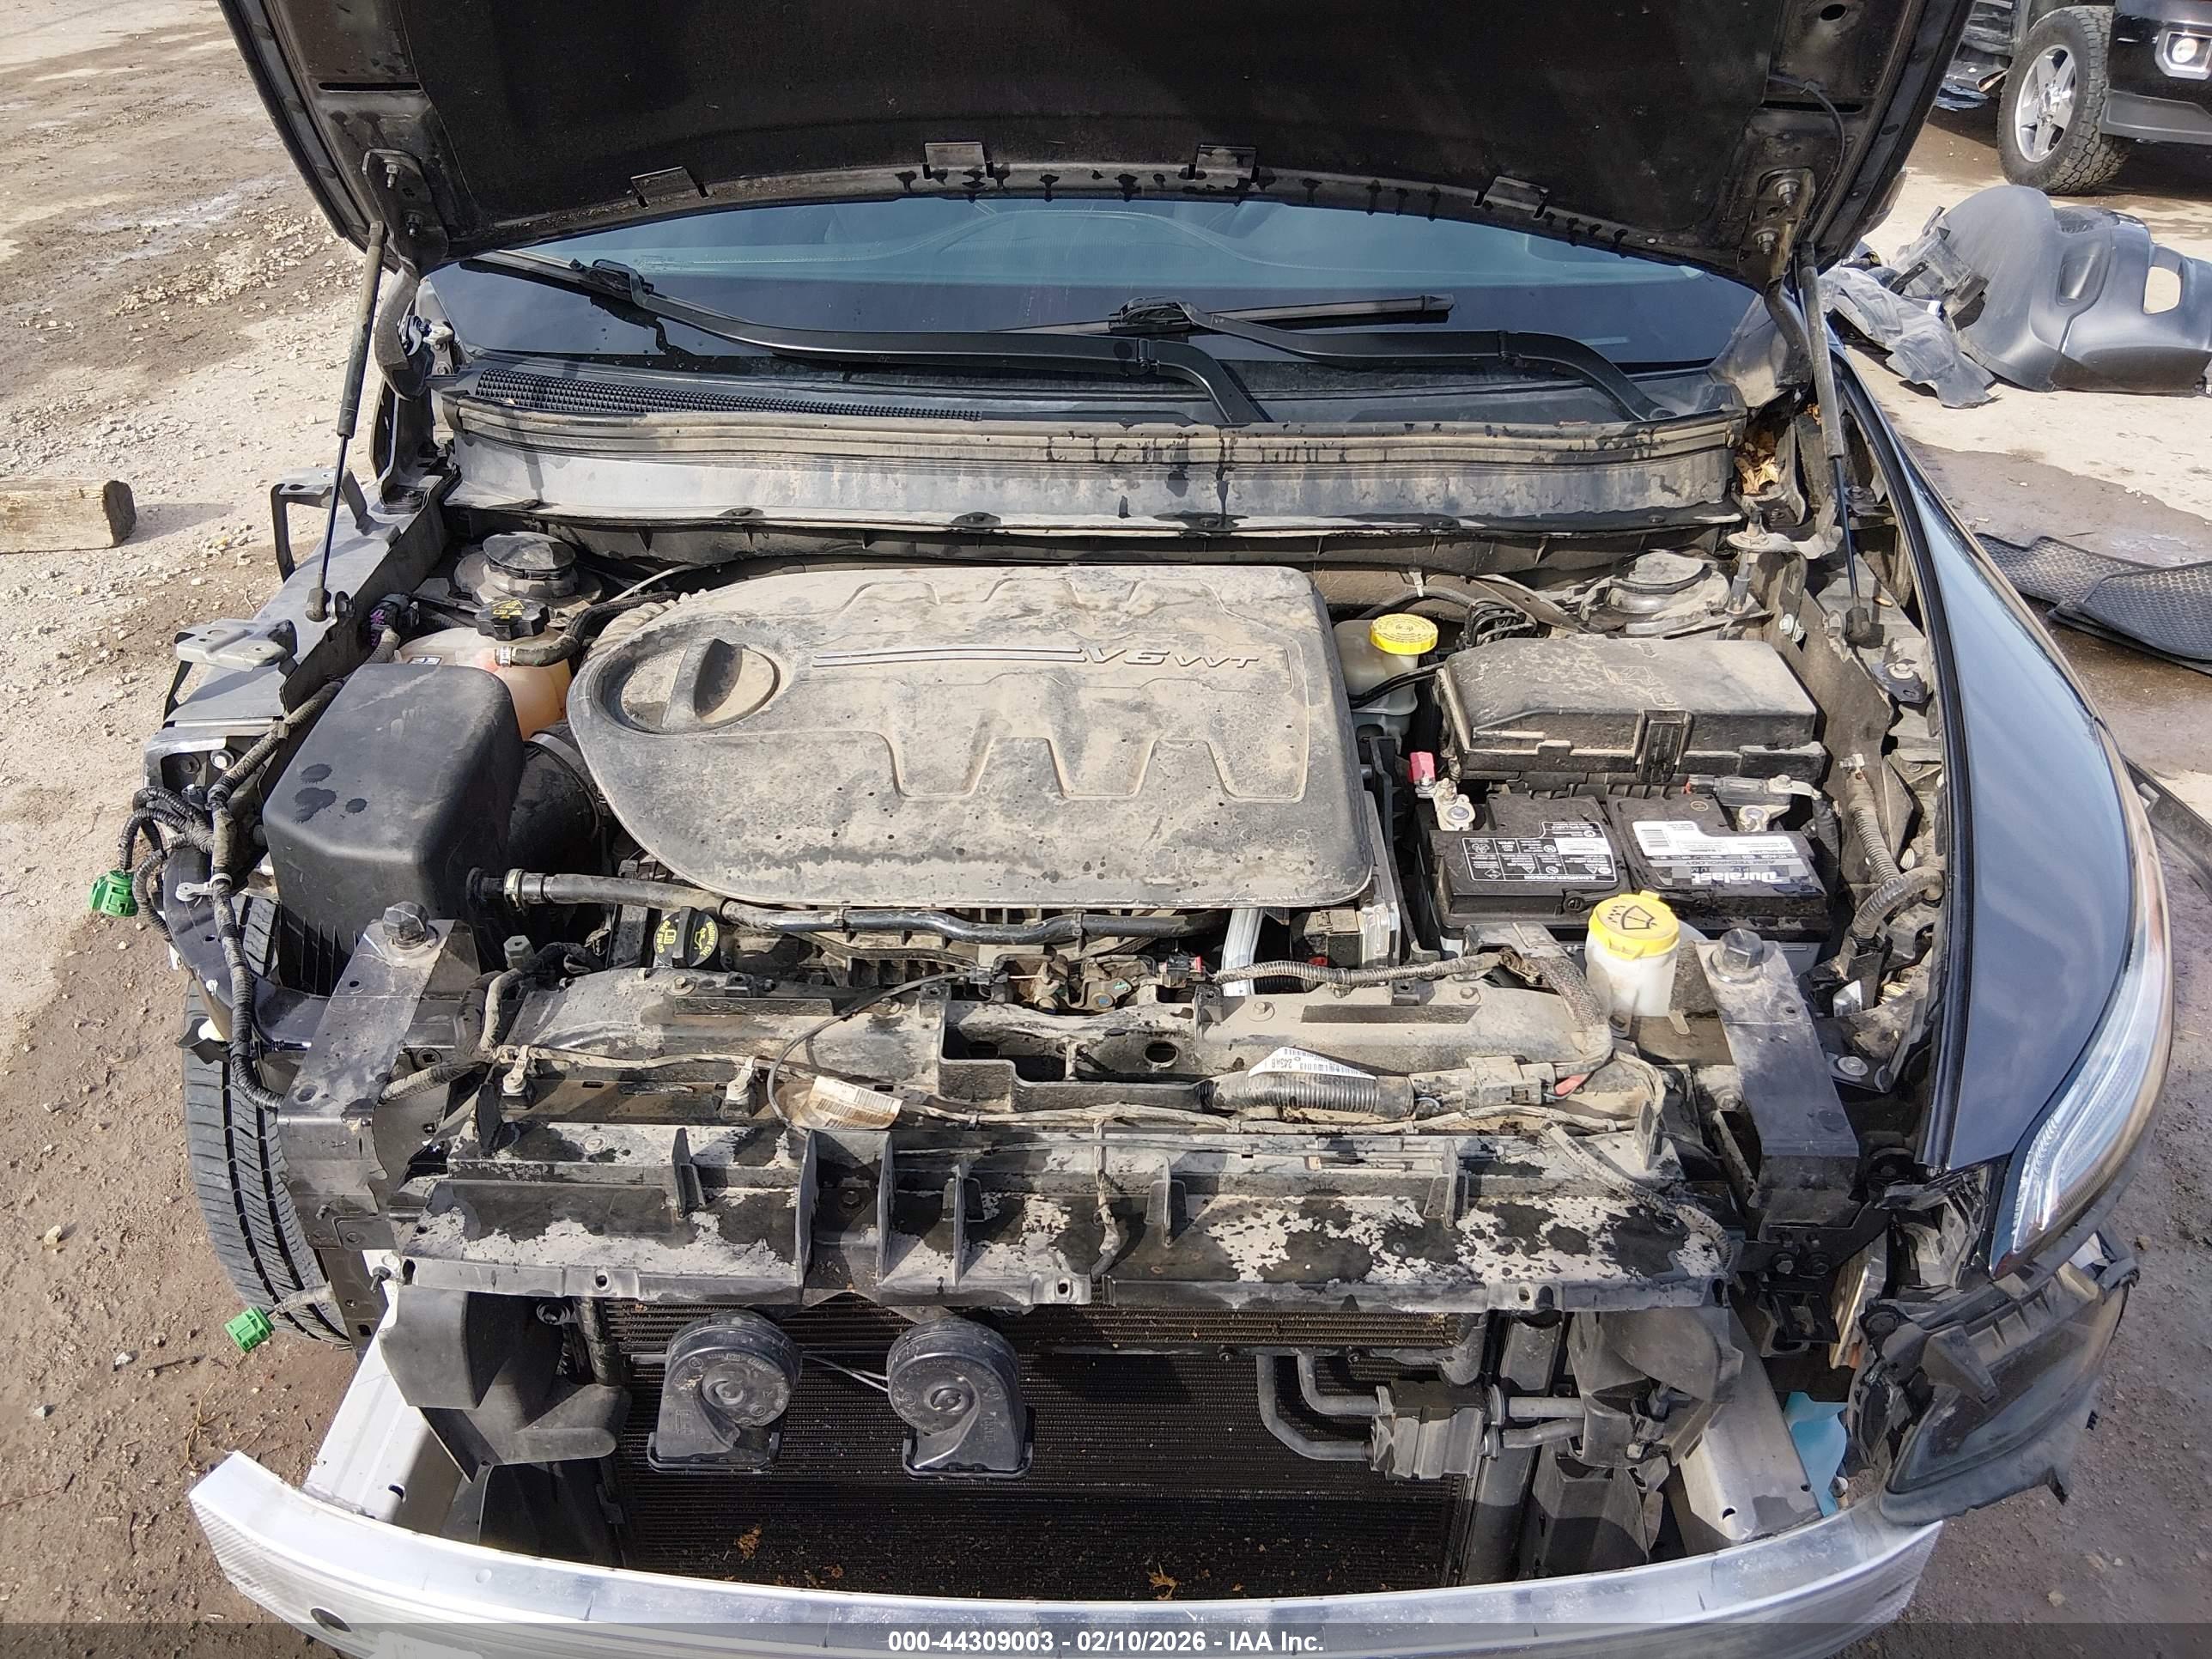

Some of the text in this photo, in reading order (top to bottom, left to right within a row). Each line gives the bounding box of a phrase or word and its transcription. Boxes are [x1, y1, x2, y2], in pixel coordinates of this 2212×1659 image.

[1086, 647, 1260, 669] V6 VVT
[1691, 871, 1783, 884] Duralast
[699, 921, 716, 957] ENGINE OIL
